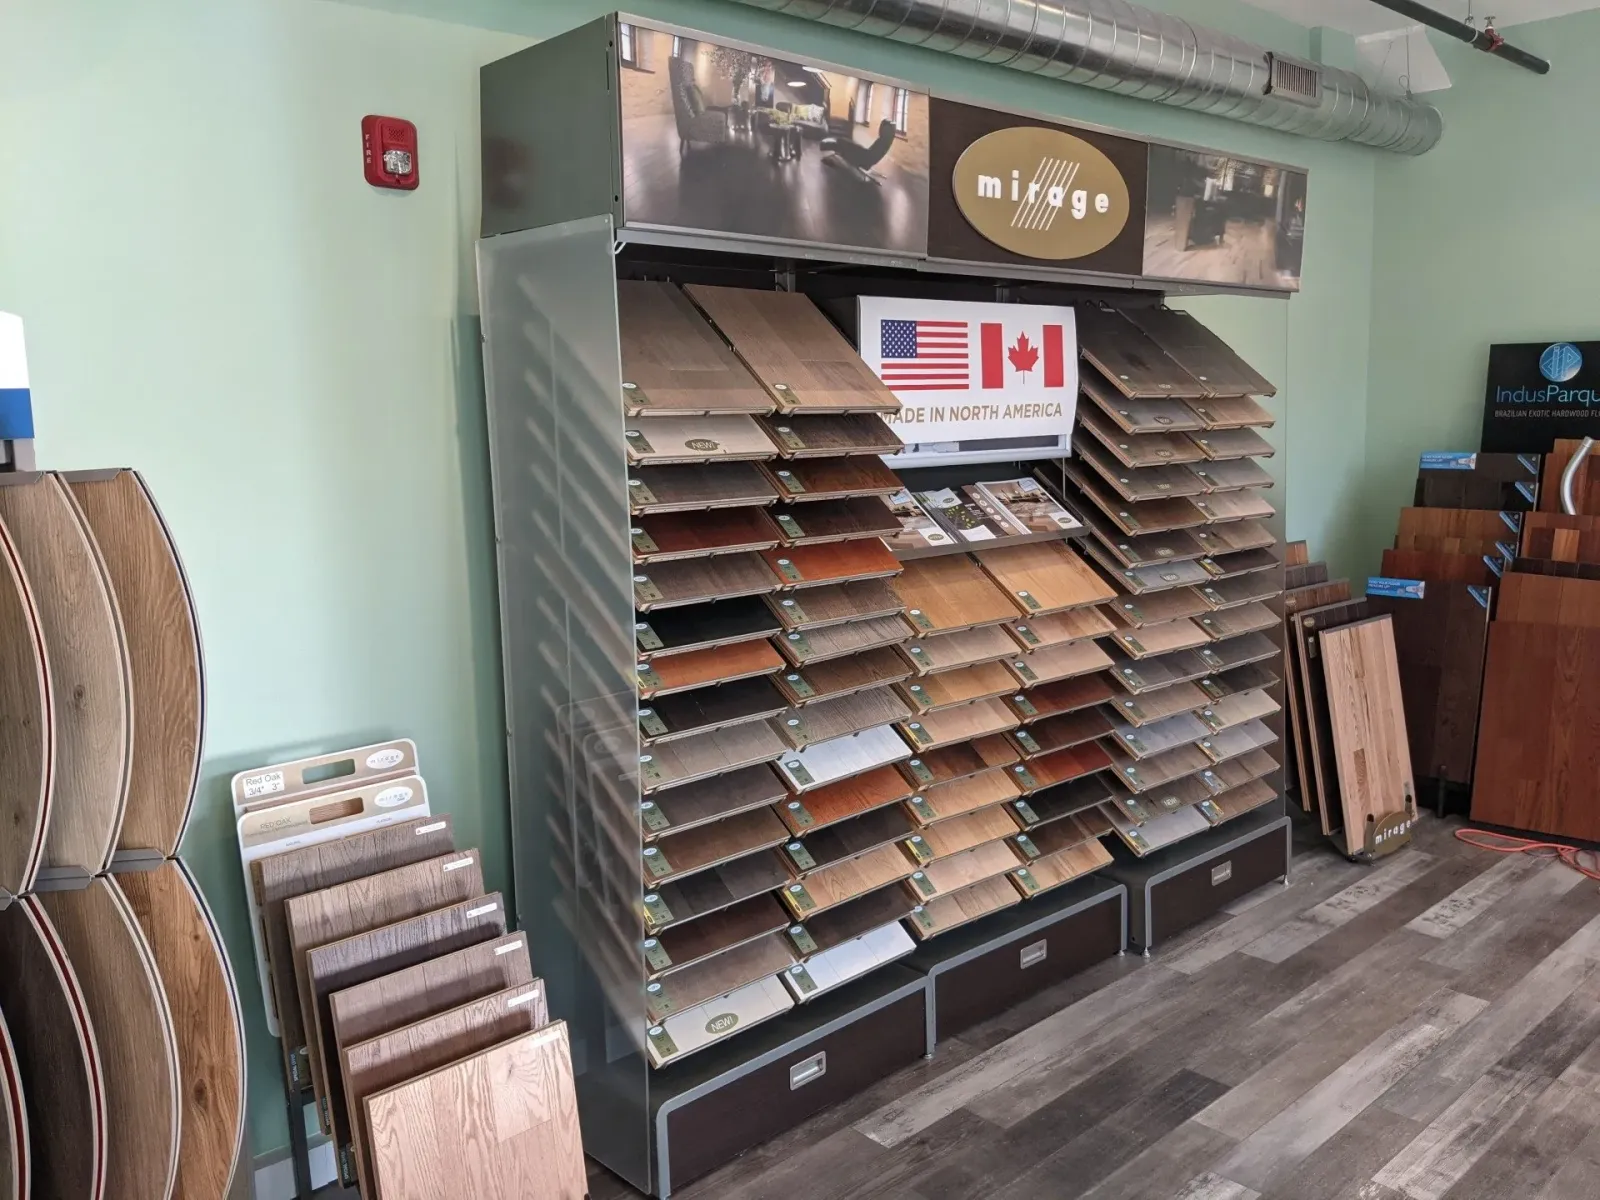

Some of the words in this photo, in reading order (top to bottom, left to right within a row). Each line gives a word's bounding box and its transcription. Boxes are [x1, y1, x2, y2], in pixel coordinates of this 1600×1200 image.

[365, 134, 373, 164] FIRE
[977, 169, 1110, 220] mirage
[930, 406, 945, 423] IN
[949, 404, 999, 421] NORTH
[1004, 402, 1063, 420] AMERICA
[1494, 409, 1527, 418] BRAZILIAN
[1528, 409, 1550, 418] EXOTIC
[1551, 409, 1589, 417] HARDWOOD
[246, 777, 263, 786] Red
[264, 773, 281, 782] Oak
[260, 821, 274, 829] RED
[275, 817, 292, 827] OAK
[1375, 820, 1411, 845] mirage
[711, 1015, 734, 1032] NEW!
